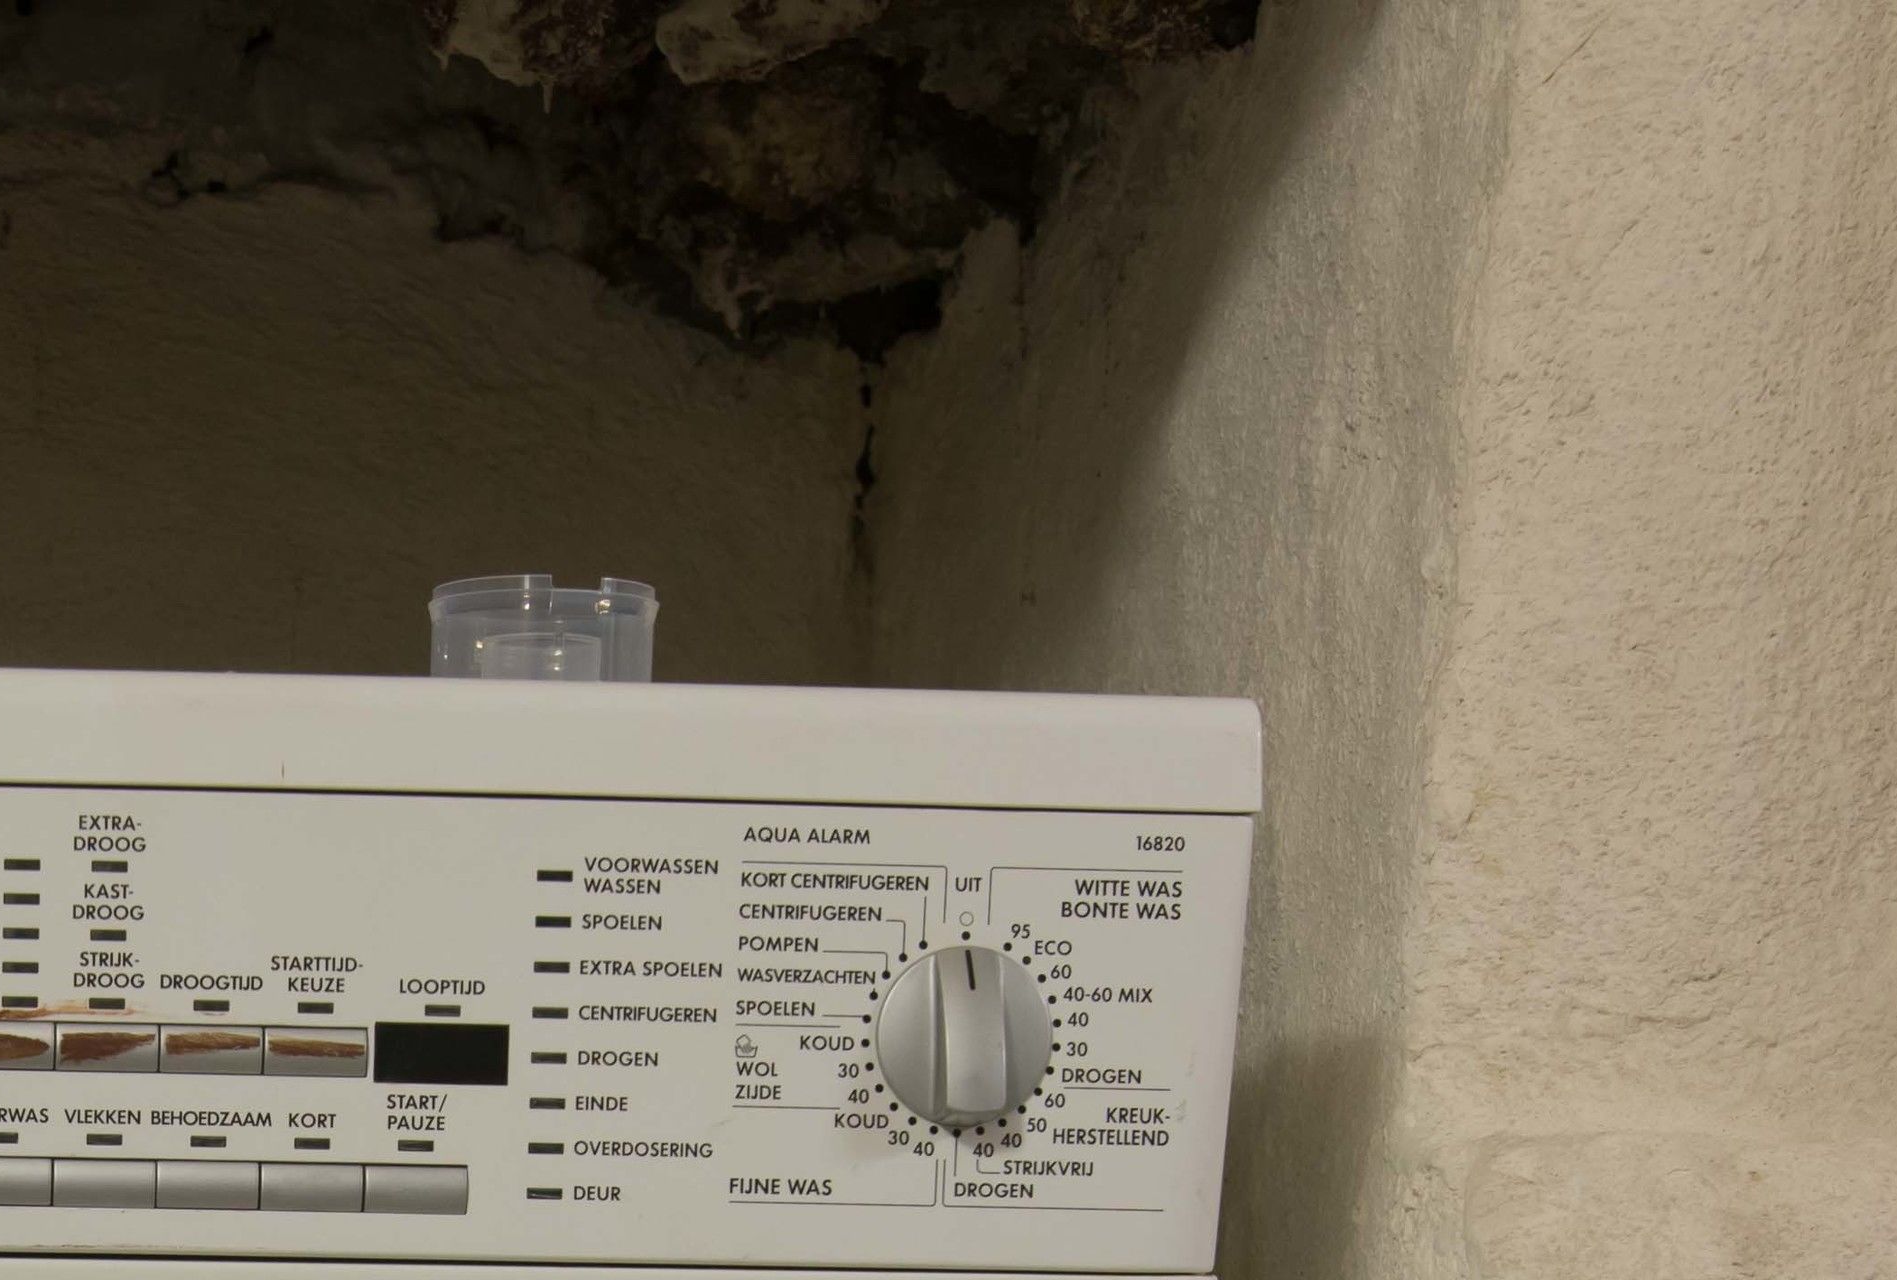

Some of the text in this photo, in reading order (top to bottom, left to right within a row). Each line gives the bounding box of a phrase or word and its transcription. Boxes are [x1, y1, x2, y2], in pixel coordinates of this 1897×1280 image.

[78, 814, 142, 832] EXTRA-
[743, 826, 871, 845] AQUA ALARM
[1136, 835, 1186, 852] 16820
[73, 836, 147, 853] DROOG
[584, 856, 719, 875] VOORWASSEN
[583, 877, 661, 895] WASSEN
[741, 871, 929, 892] KORT CENTRIFUGEREN
[955, 876, 982, 893] UIT
[1074, 879, 1183, 898] WITTE WAS
[83, 883, 134, 900] KAST-
[72, 904, 145, 921] DROOG
[739, 903, 882, 922] CENTRIFUGEREN
[1061, 901, 1181, 921] BONTE WAS
[582, 913, 662, 931] SPOELEN
[1011, 923, 1031, 940] 95
[738, 935, 819, 953] POMPEN
[1034, 939, 1073, 956] ECO
[79, 951, 140, 968] STRIJK-
[270, 955, 363, 973] STARTTIJD-
[579, 959, 723, 978] EXTRA SPOELEN
[737, 967, 876, 985] WASVERZACHTEN
[1050, 964, 1072, 980] 60
[73, 972, 145, 989] DROOG
[160, 974, 264, 991] DROOGTIJD
[287, 977, 345, 993] KEUZE
[399, 978, 486, 996] LOOPTIJD
[1063, 986, 1153, 1004] 40-60 MIX
[578, 1005, 717, 1023] CENTRIFUGEREN
[735, 999, 816, 1017] SPOELEN
[1067, 1011, 1089, 1027] 40
[799, 1035, 855, 1052] KOUD
[1066, 1041, 1088, 1057] 30
[577, 1050, 659, 1067] DROGEN
[736, 1061, 778, 1077] WOL
[837, 1062, 860, 1079] 30
[1061, 1067, 1142, 1085] DROGEN
[735, 1084, 782, 1101] ZIJDE
[847, 1088, 870, 1105] 40
[1044, 1093, 1066, 1109] 60
[386, 1093, 448, 1113] START/
[575, 1095, 628, 1112] EINDE
[64, 1108, 142, 1125] VLEKKEN
[150, 1110, 272, 1127] BEHOEDZAAM
[288, 1112, 337, 1129] KORT
[387, 1115, 446, 1131] PAUZE
[834, 1113, 890, 1129] KOUD
[1106, 1107, 1171, 1125] KREUK-
[1026, 1117, 1048, 1133] 50
[887, 1129, 910, 1146] 30
[999, 1132, 1023, 1149] 40
[1052, 1128, 1170, 1147] HERSTELLEND
[573, 1140, 714, 1159] OVERDOSERING
[912, 1141, 935, 1157] 40
[972, 1141, 995, 1158] 40
[1003, 1159, 1094, 1177] STRIJKVRIJ
[573, 1185, 621, 1202] DEUR
[729, 1177, 833, 1196] FIJNE WAS
[954, 1182, 1034, 1199] DROGEN
